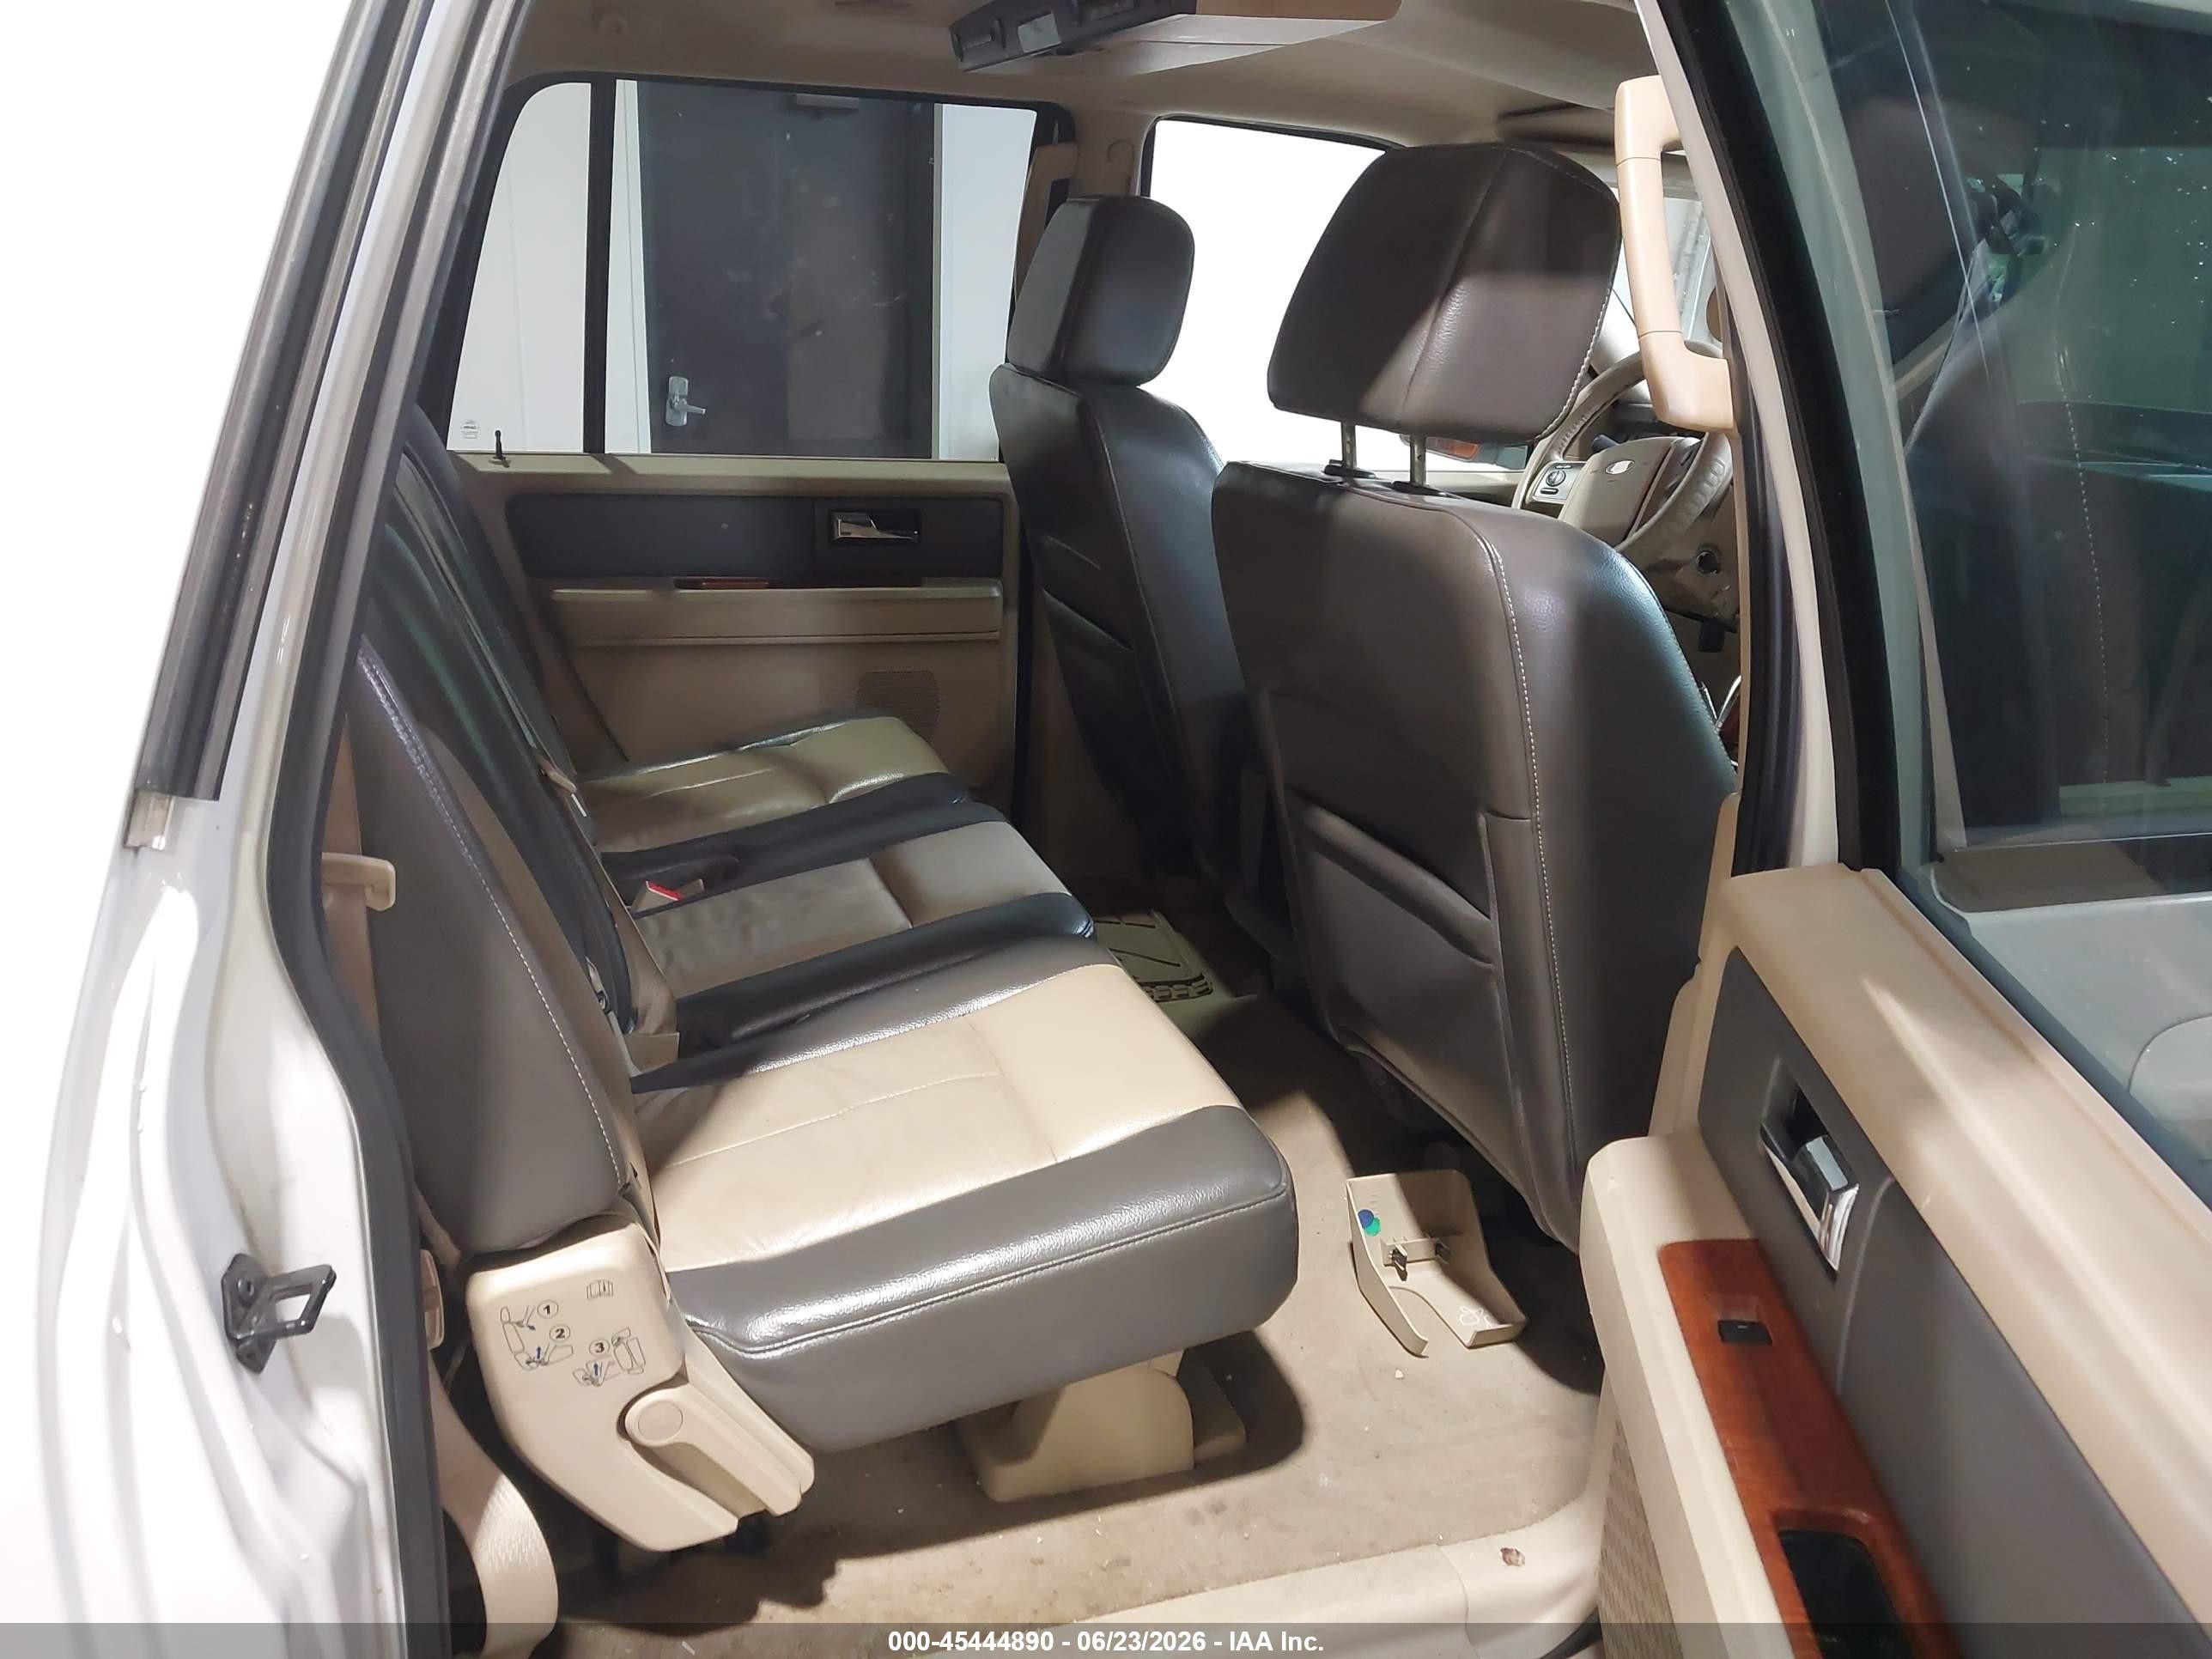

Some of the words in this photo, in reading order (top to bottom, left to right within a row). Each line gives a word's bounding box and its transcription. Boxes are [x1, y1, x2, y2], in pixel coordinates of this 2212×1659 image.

[543, 1304, 550, 1315] 1
[555, 1328, 566, 1339] 2
[595, 1342, 605, 1353] 3
